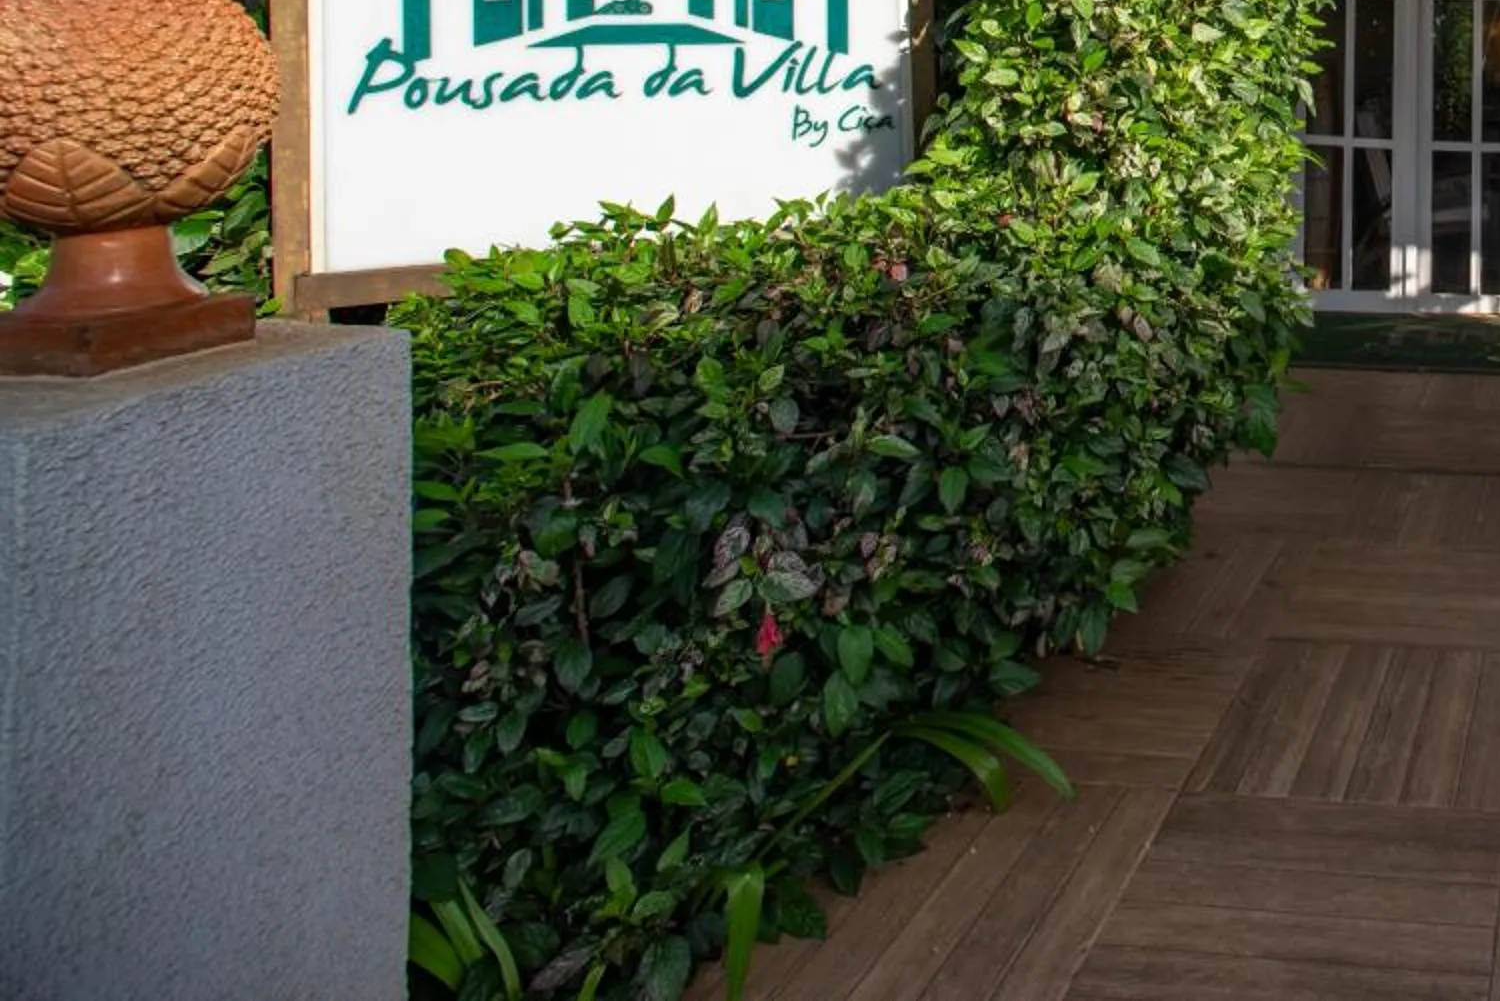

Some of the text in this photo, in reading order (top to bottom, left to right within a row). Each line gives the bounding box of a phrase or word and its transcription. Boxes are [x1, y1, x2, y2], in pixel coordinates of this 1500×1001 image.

[347, 38, 882, 116] Pousada da Villa
[791, 104, 828, 147] By
